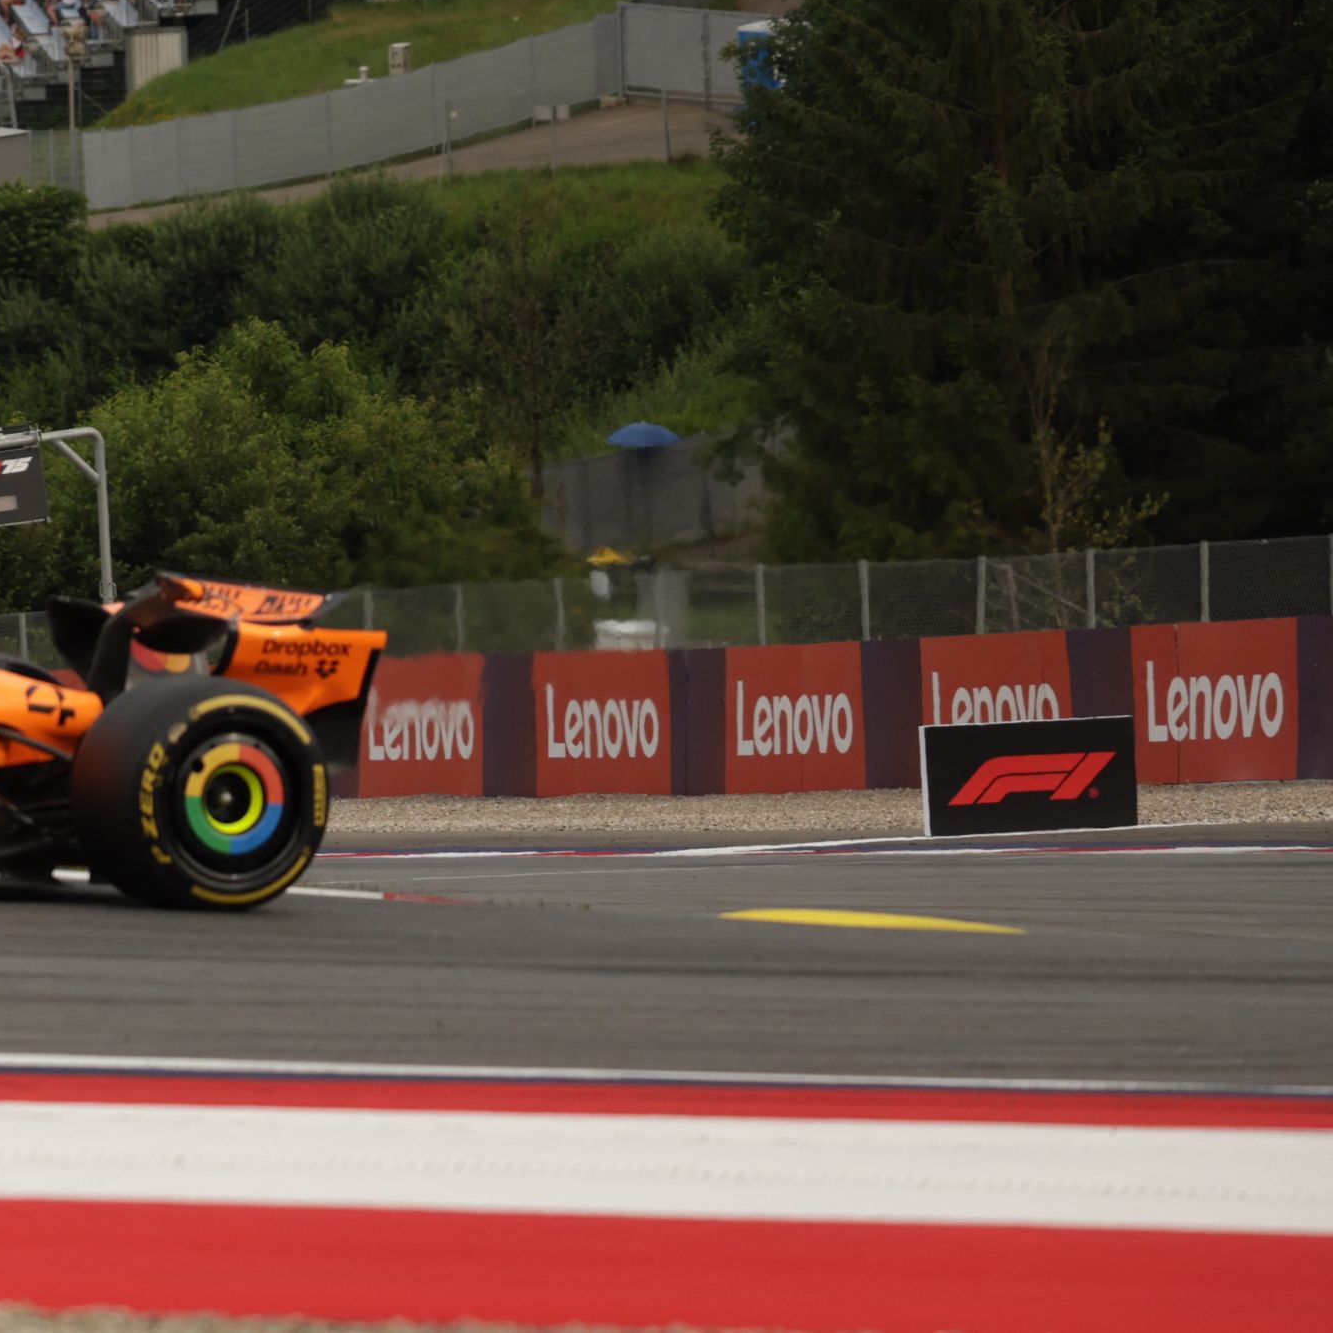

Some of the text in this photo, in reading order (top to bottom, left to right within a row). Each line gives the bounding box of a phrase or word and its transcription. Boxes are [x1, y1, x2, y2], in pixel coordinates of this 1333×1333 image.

[262, 639, 351, 658] Dropbox
[368, 686, 474, 761] Lenovo
[546, 683, 659, 758] Lenovo
[736, 681, 853, 756] Lenovo
[1146, 660, 1284, 742] Lenovo
[139, 741, 165, 840] ZERO
